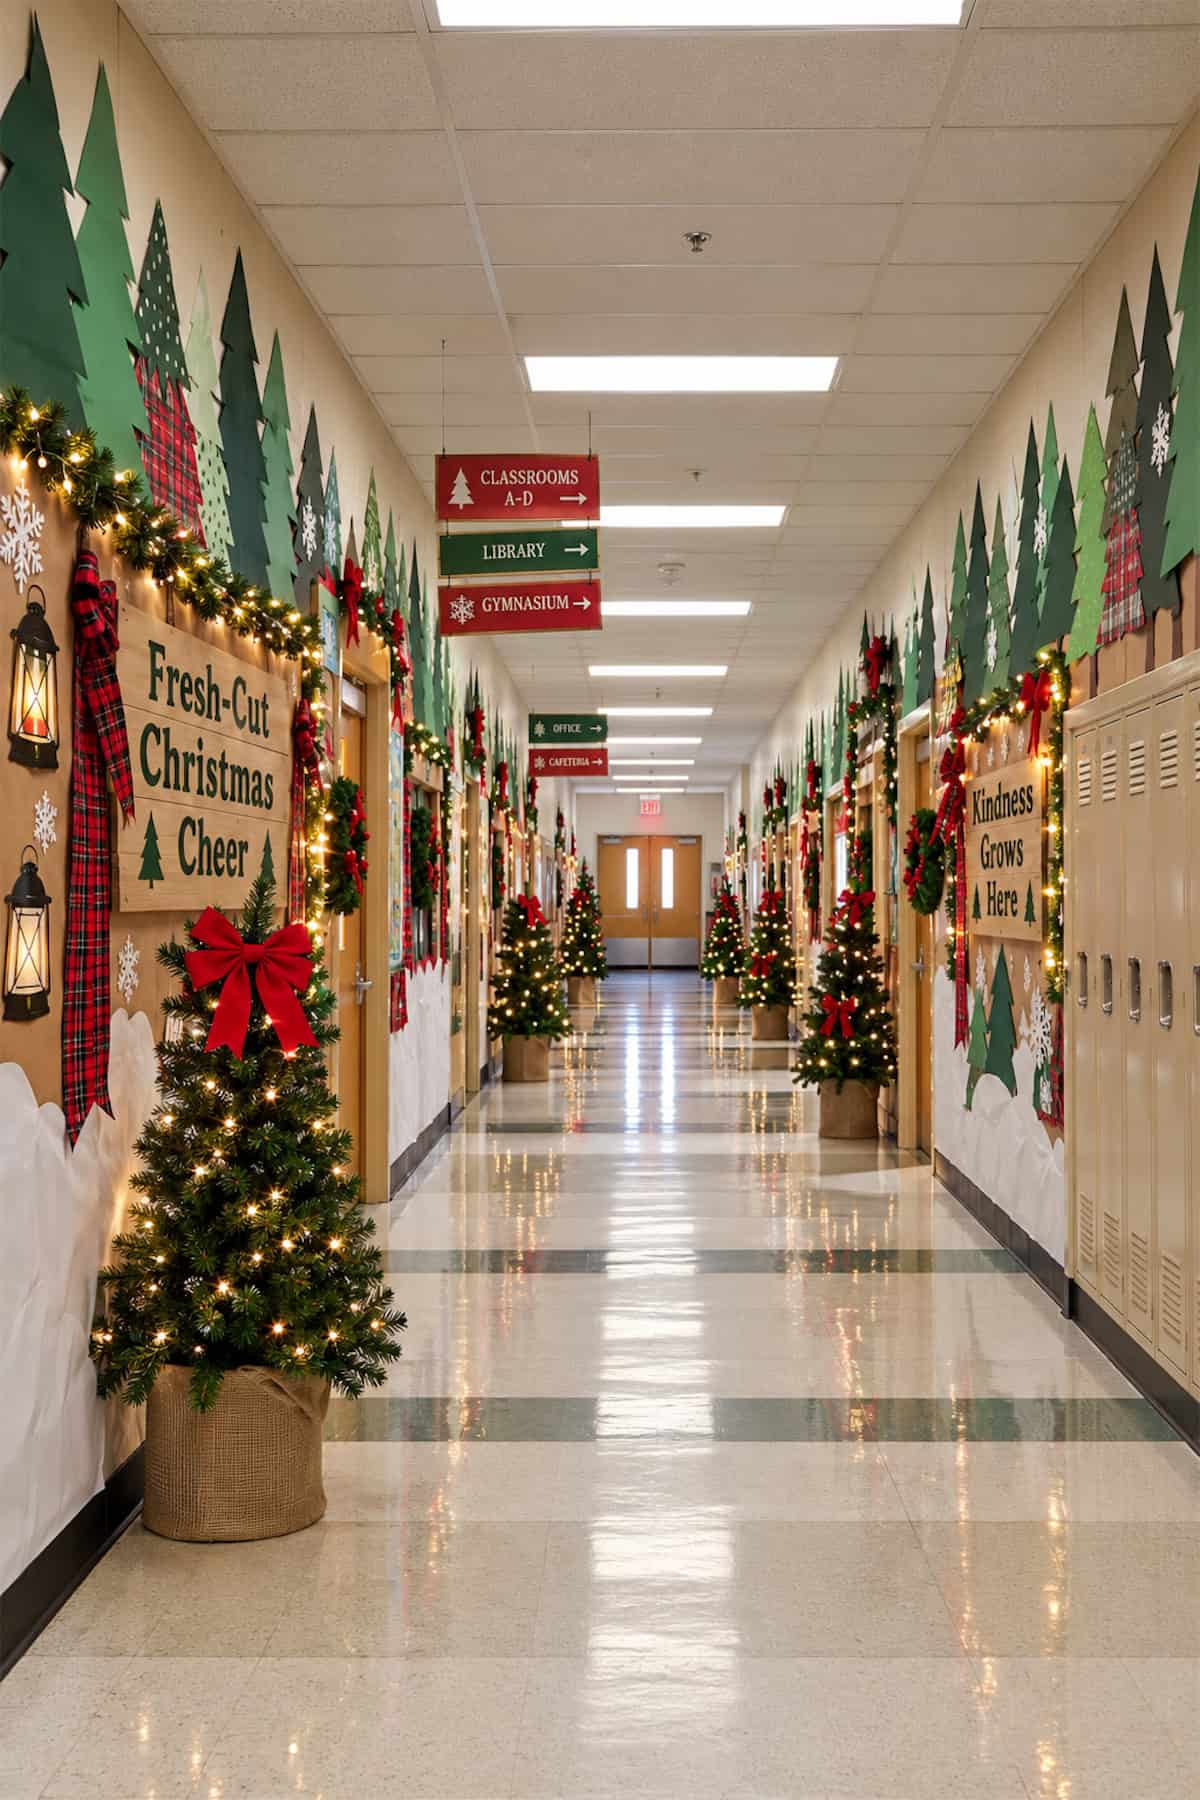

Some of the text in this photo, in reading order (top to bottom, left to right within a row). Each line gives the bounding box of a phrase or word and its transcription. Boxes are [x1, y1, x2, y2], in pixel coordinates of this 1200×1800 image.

[480, 469, 579, 485] CLASSROOMS
[504, 490, 534, 507] A-D
[483, 543, 545, 560] LIBRARY
[481, 595, 569, 613] GYMNASIUM
[147, 639, 270, 739] Fresh-Cut
[553, 723, 582, 733] OFFICE
[139, 722, 274, 811] Christmas
[972, 781, 1033, 825] Kindness
[177, 815, 249, 878] Cheer
[980, 833, 1024, 870] Grows
[986, 880, 1019, 918] Here
